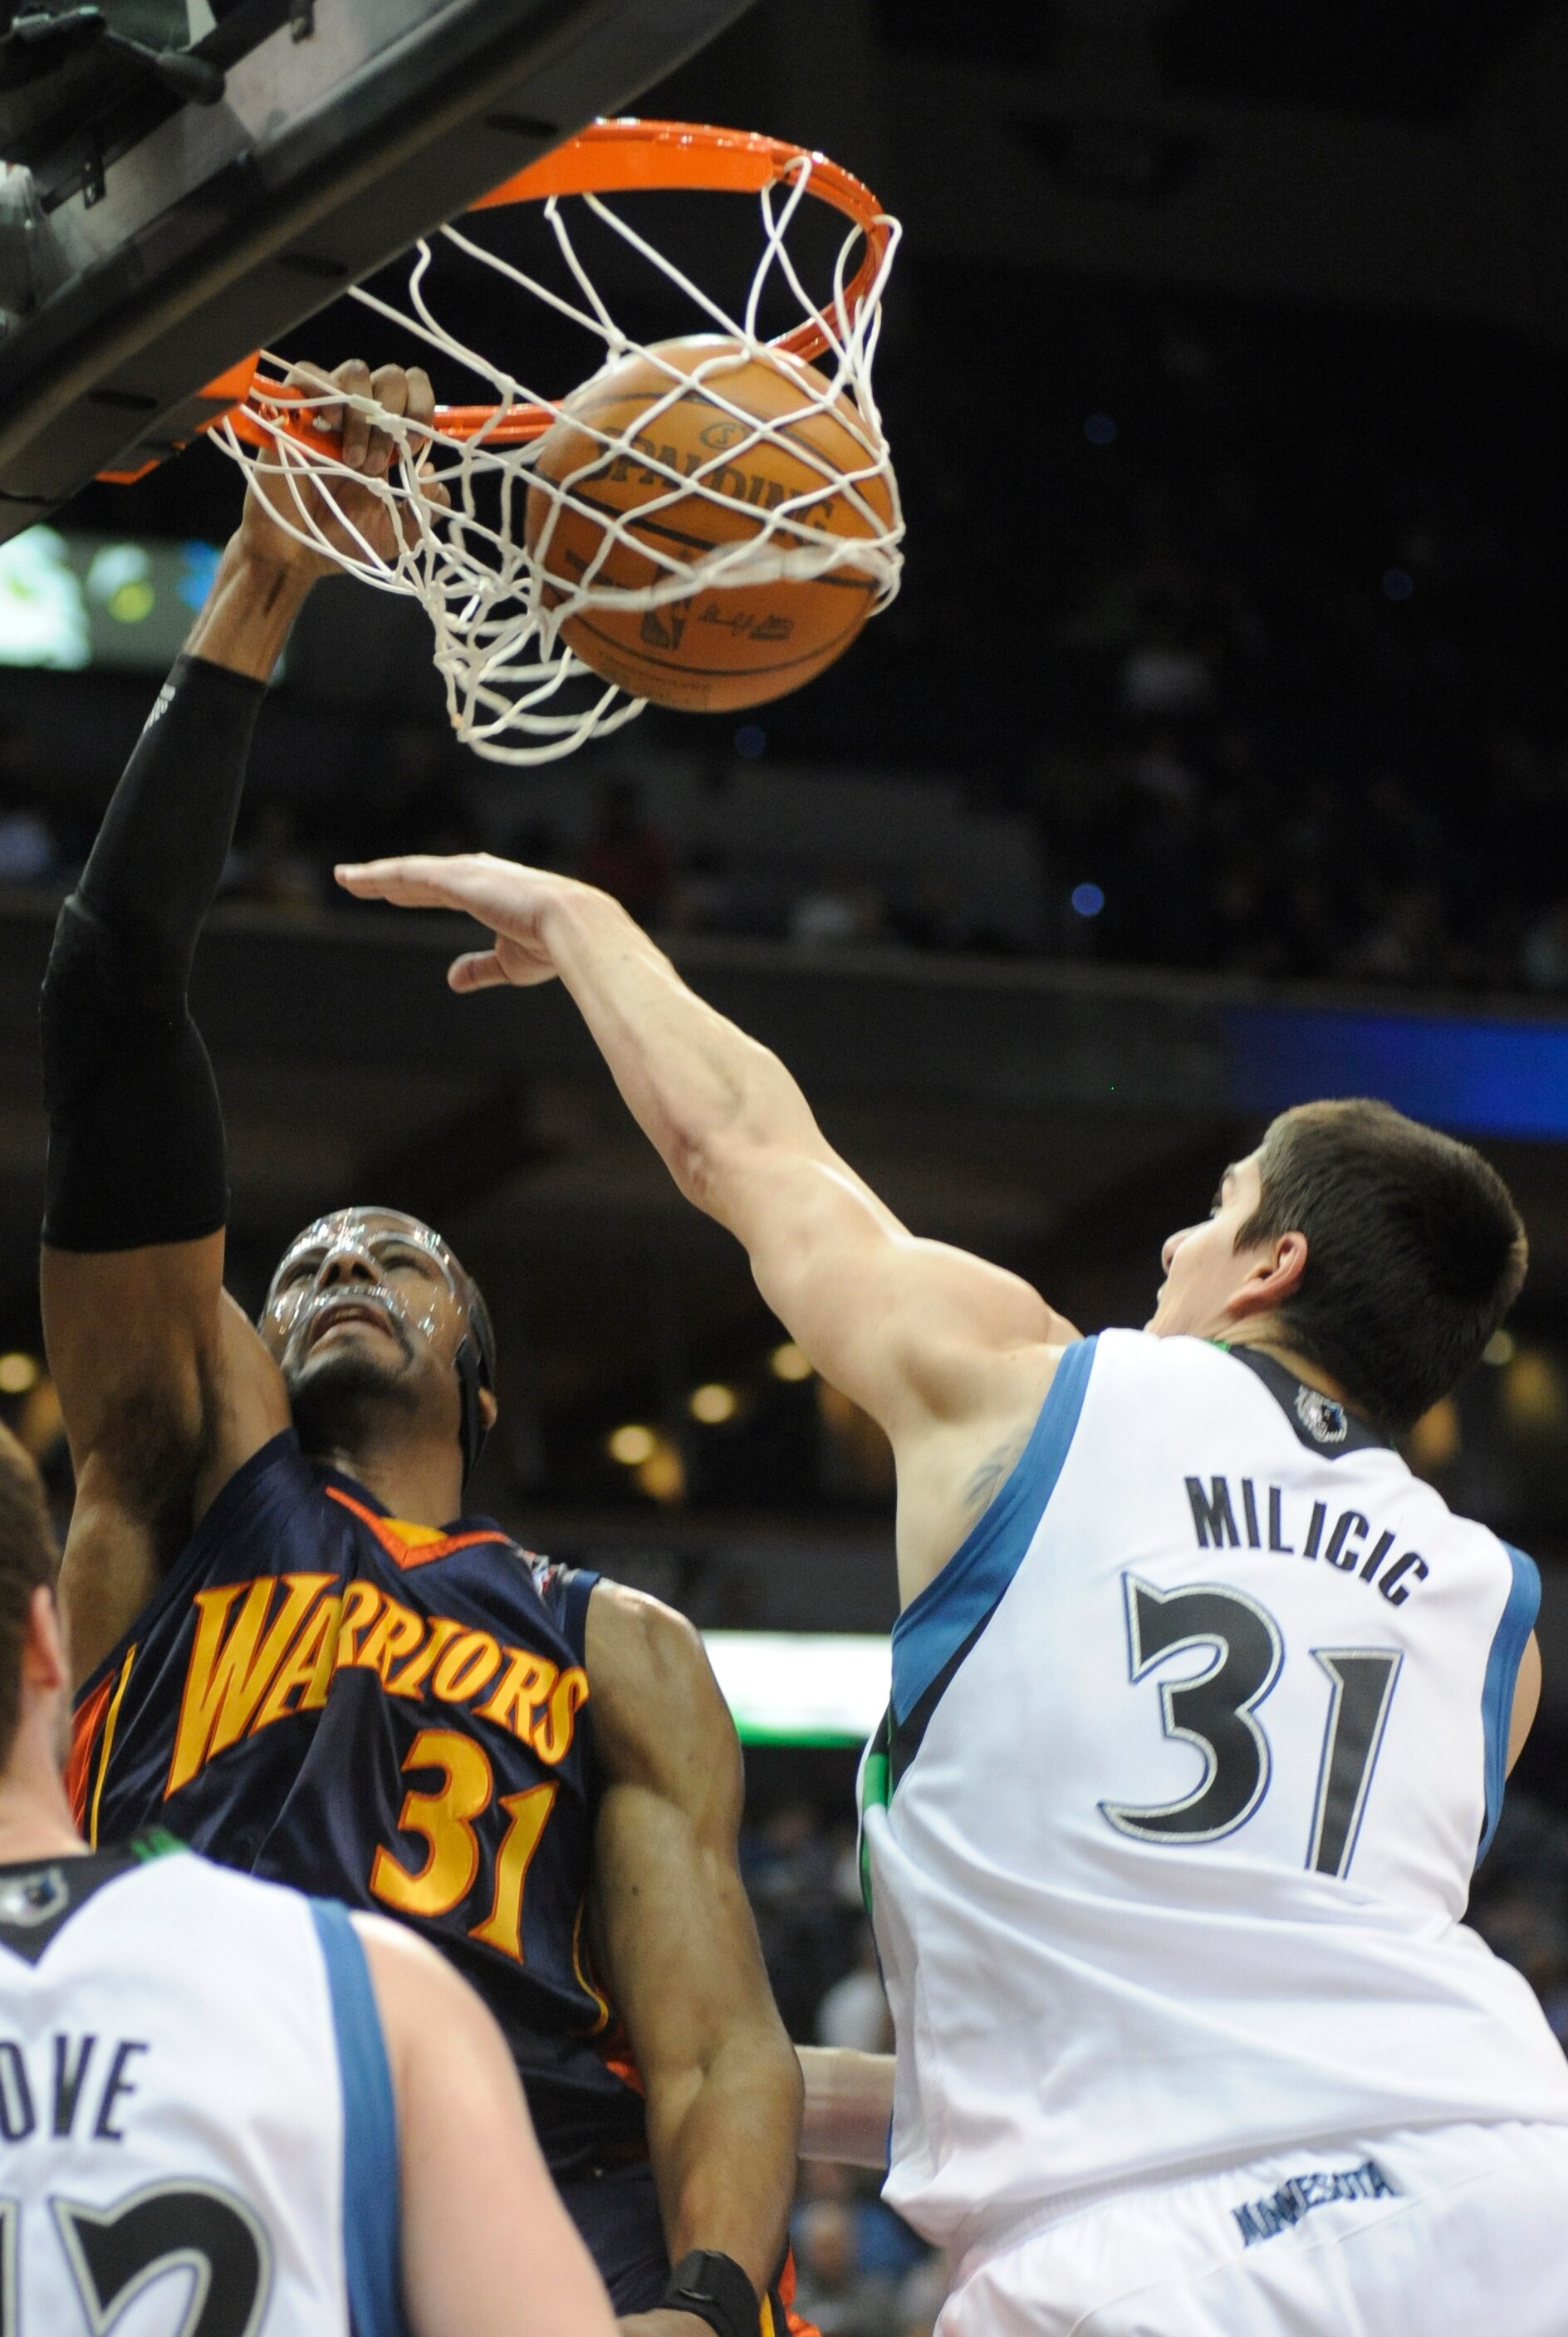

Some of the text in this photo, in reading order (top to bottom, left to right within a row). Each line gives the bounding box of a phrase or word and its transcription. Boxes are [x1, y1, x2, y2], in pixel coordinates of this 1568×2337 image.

[1183, 1477, 1429, 1607] MILICIC
[164, 1573, 590, 1801] WARRIORS
[1097, 1571, 1404, 1879] 31
[370, 1728, 560, 1963] 31
